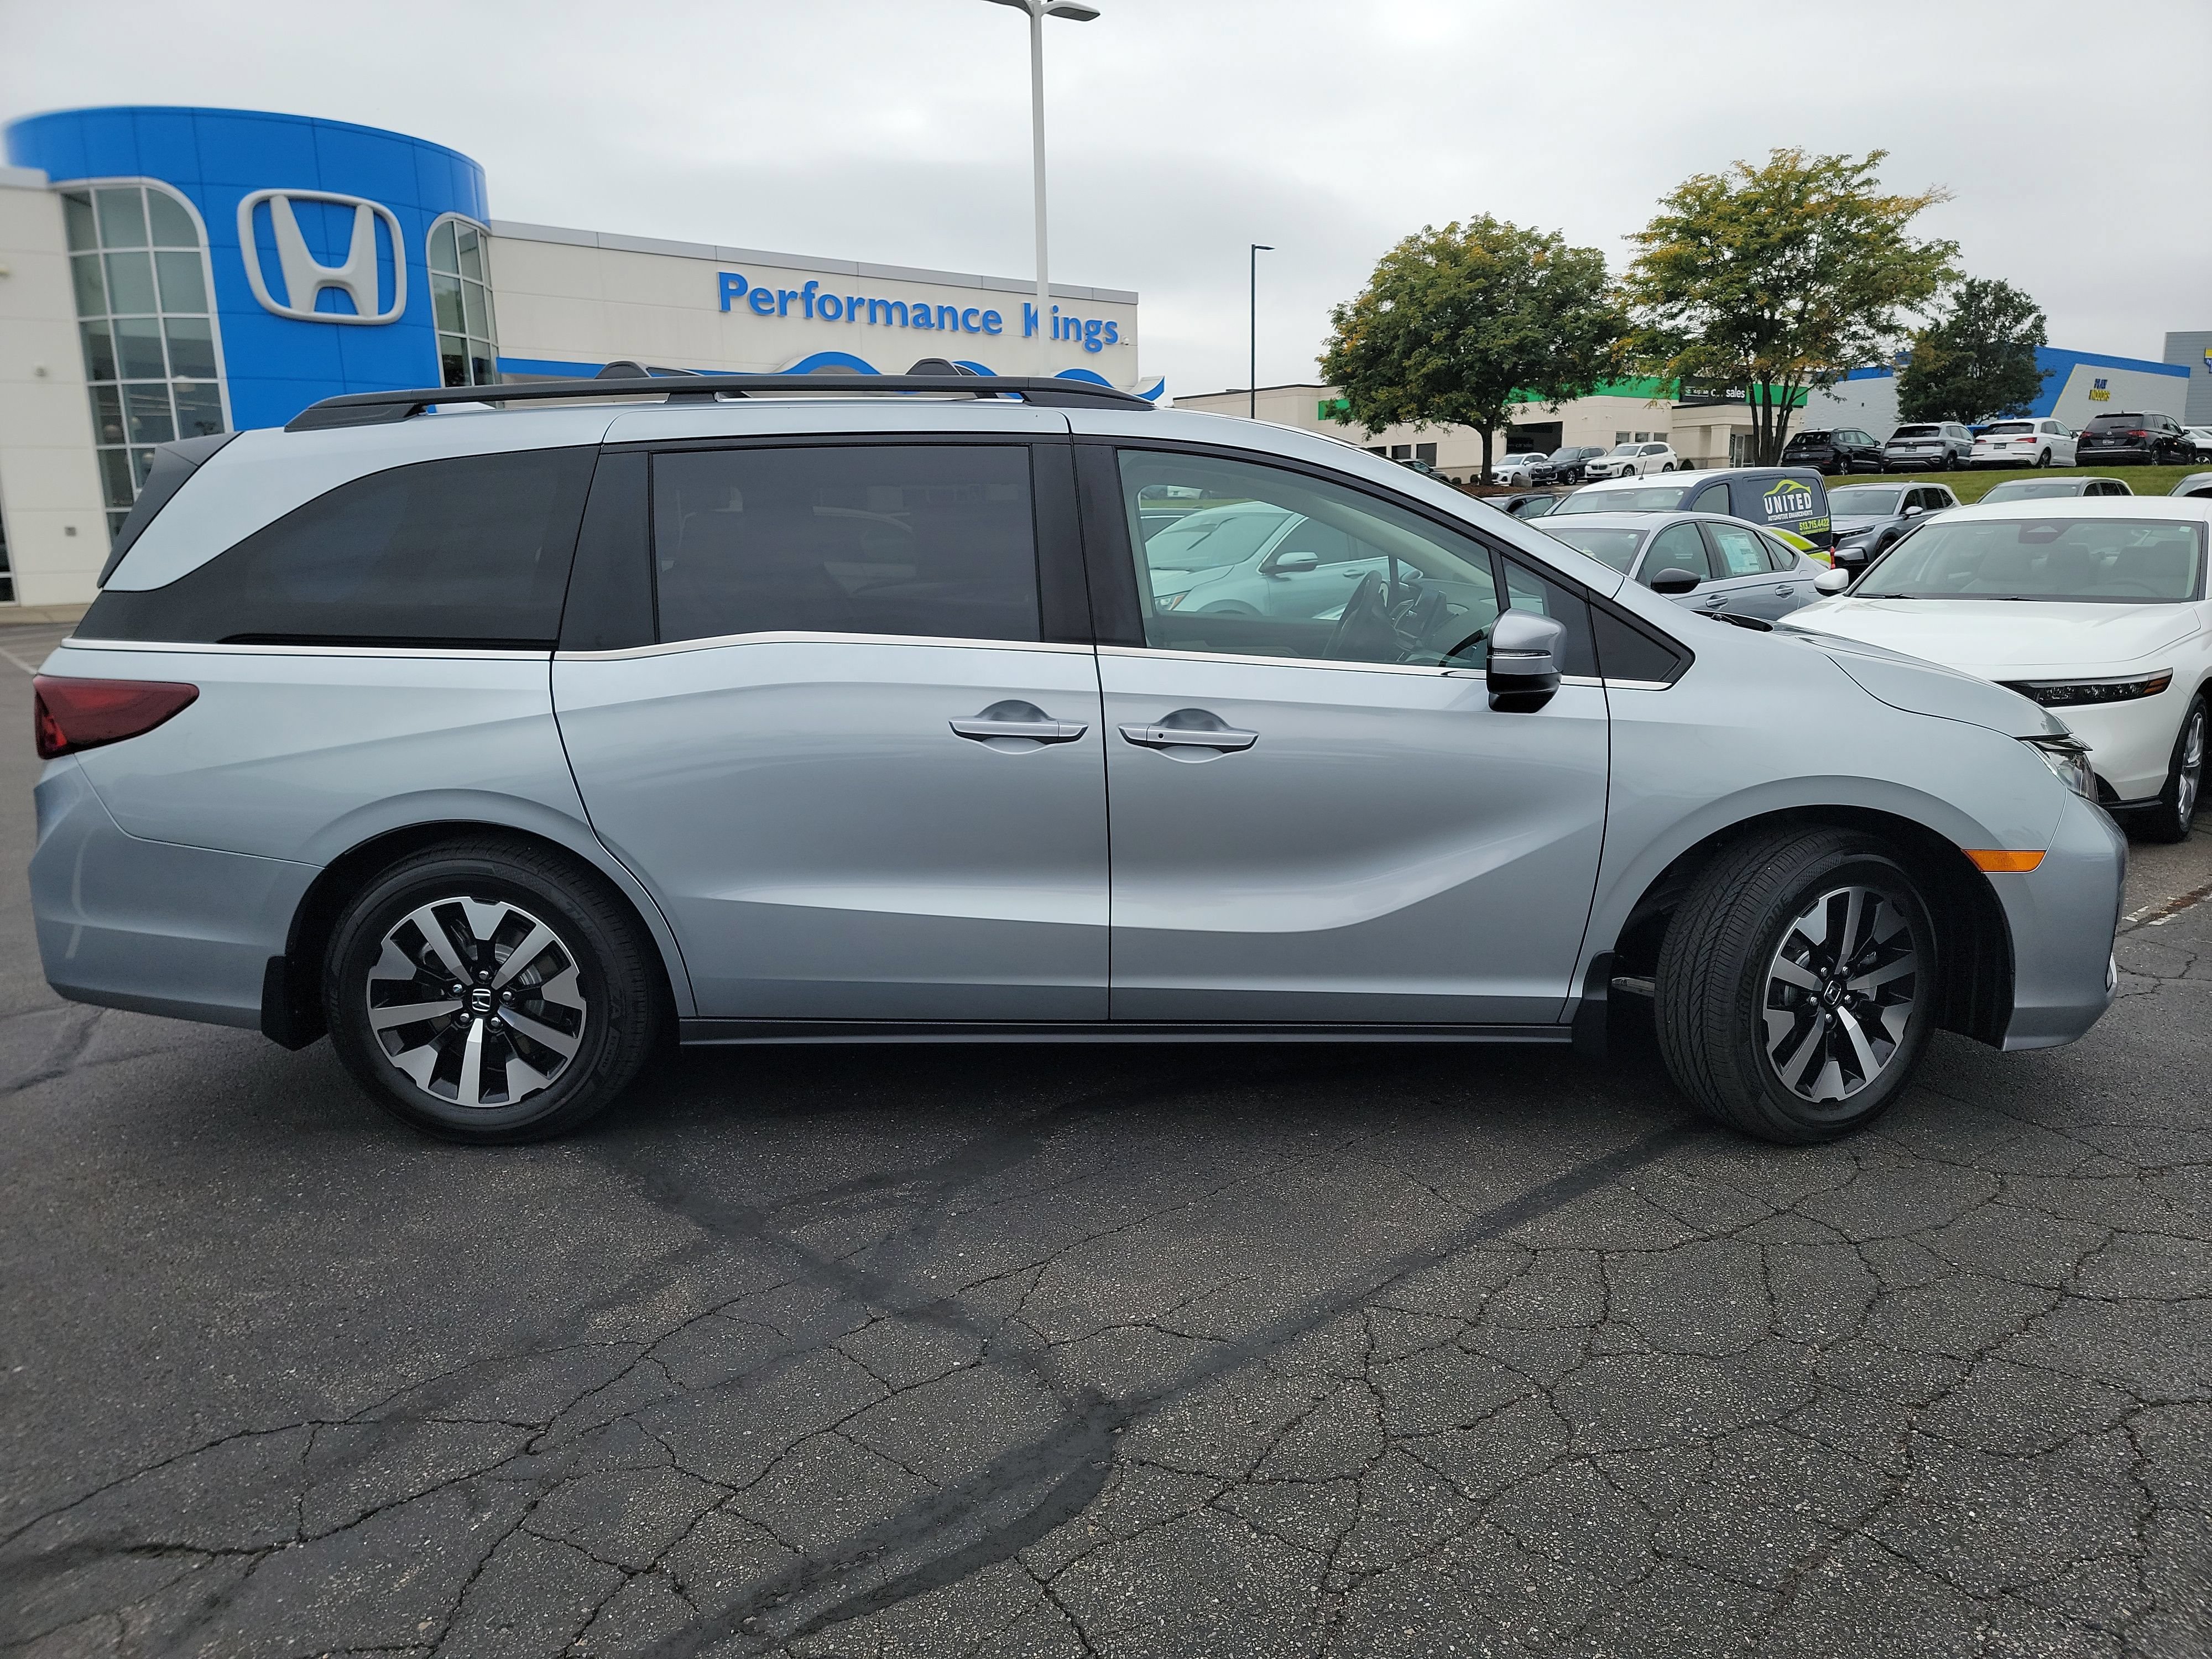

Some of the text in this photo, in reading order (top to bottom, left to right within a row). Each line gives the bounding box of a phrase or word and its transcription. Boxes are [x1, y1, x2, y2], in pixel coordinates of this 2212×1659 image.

[717, 272, 1119, 353] Performance Kings
[1726, 386, 1745, 398] sales
[1764, 492, 1812, 514] UNITED
[1799, 518, 1830, 531] 513.715.4422
